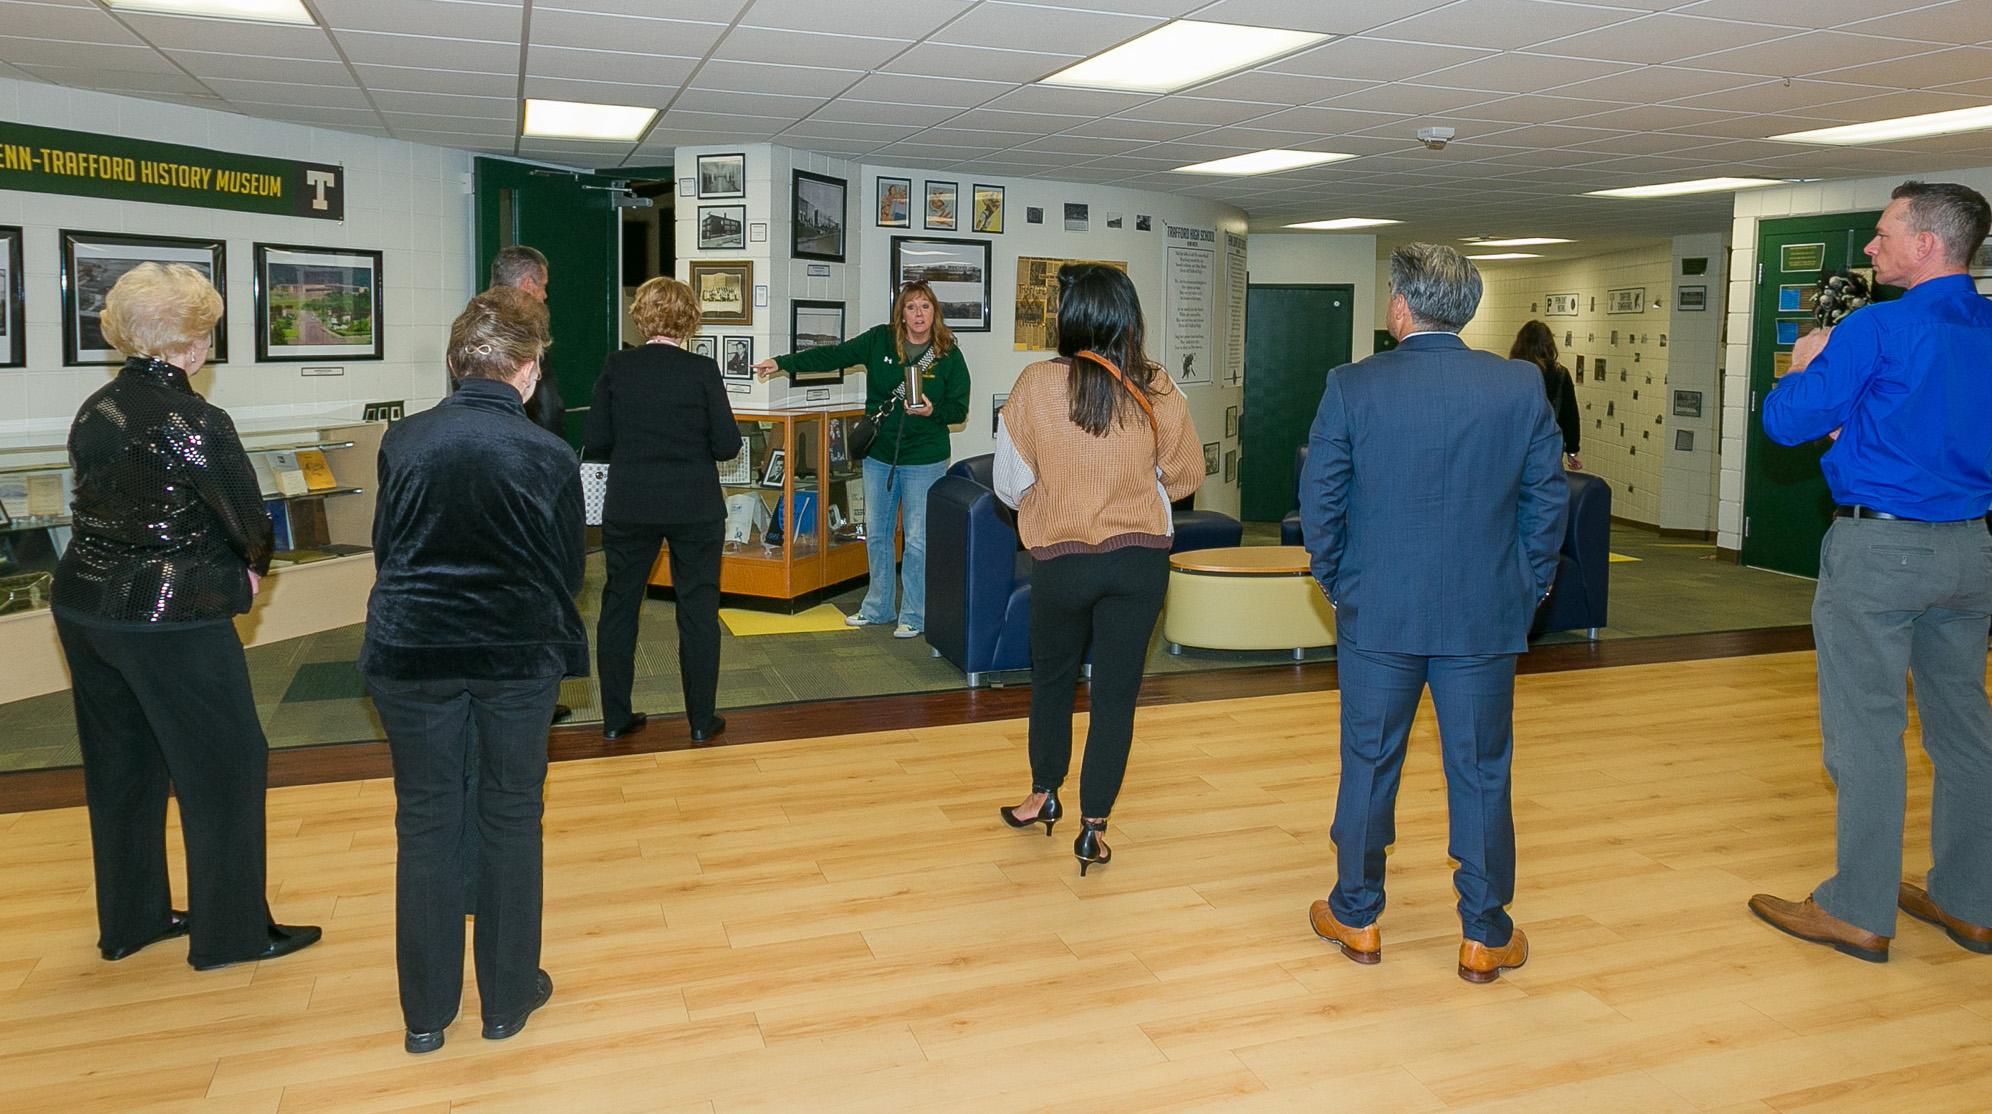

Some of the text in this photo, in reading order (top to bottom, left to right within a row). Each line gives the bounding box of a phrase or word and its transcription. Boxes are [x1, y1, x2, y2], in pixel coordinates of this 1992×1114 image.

[140, 160, 211, 190] HISTORY
[215, 169, 281, 197] MUSEUM
[306, 170, 335, 211] T
[1167, 226, 1190, 240] TRAFFORD
[1200, 230, 1215, 242] SCHOOL
